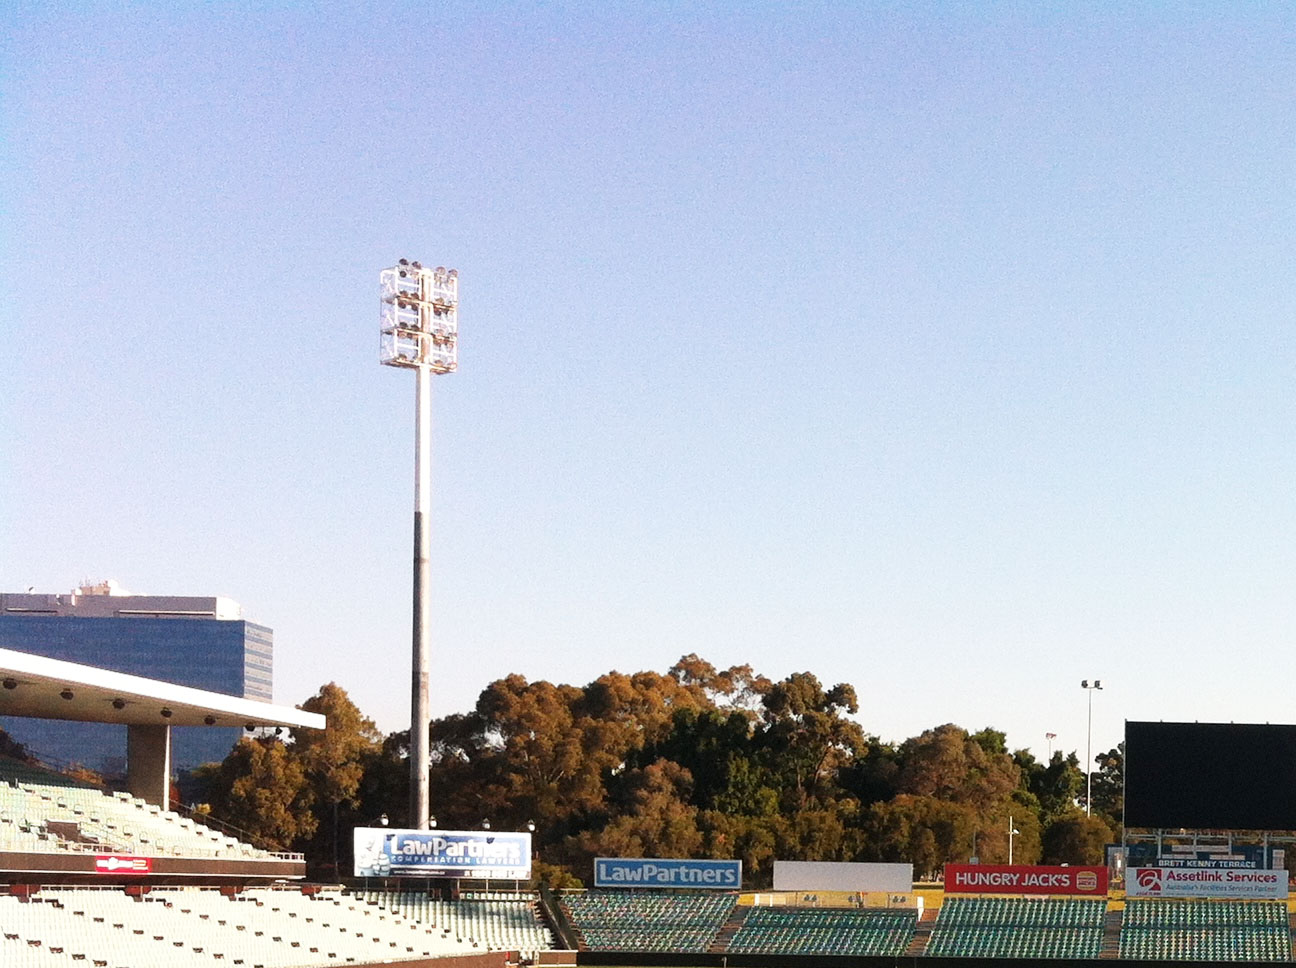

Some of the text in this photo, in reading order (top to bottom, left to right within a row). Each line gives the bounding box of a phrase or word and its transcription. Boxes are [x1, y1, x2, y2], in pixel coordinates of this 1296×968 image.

[390, 834, 521, 858] LawPartners
[1187, 860, 1217, 868] KENNY
[600, 863, 736, 883] LawPartners
[956, 872, 1019, 886] HUNGRY
[1021, 873, 1071, 887] JACK'S
[1166, 870, 1277, 883] Assetlink Services
